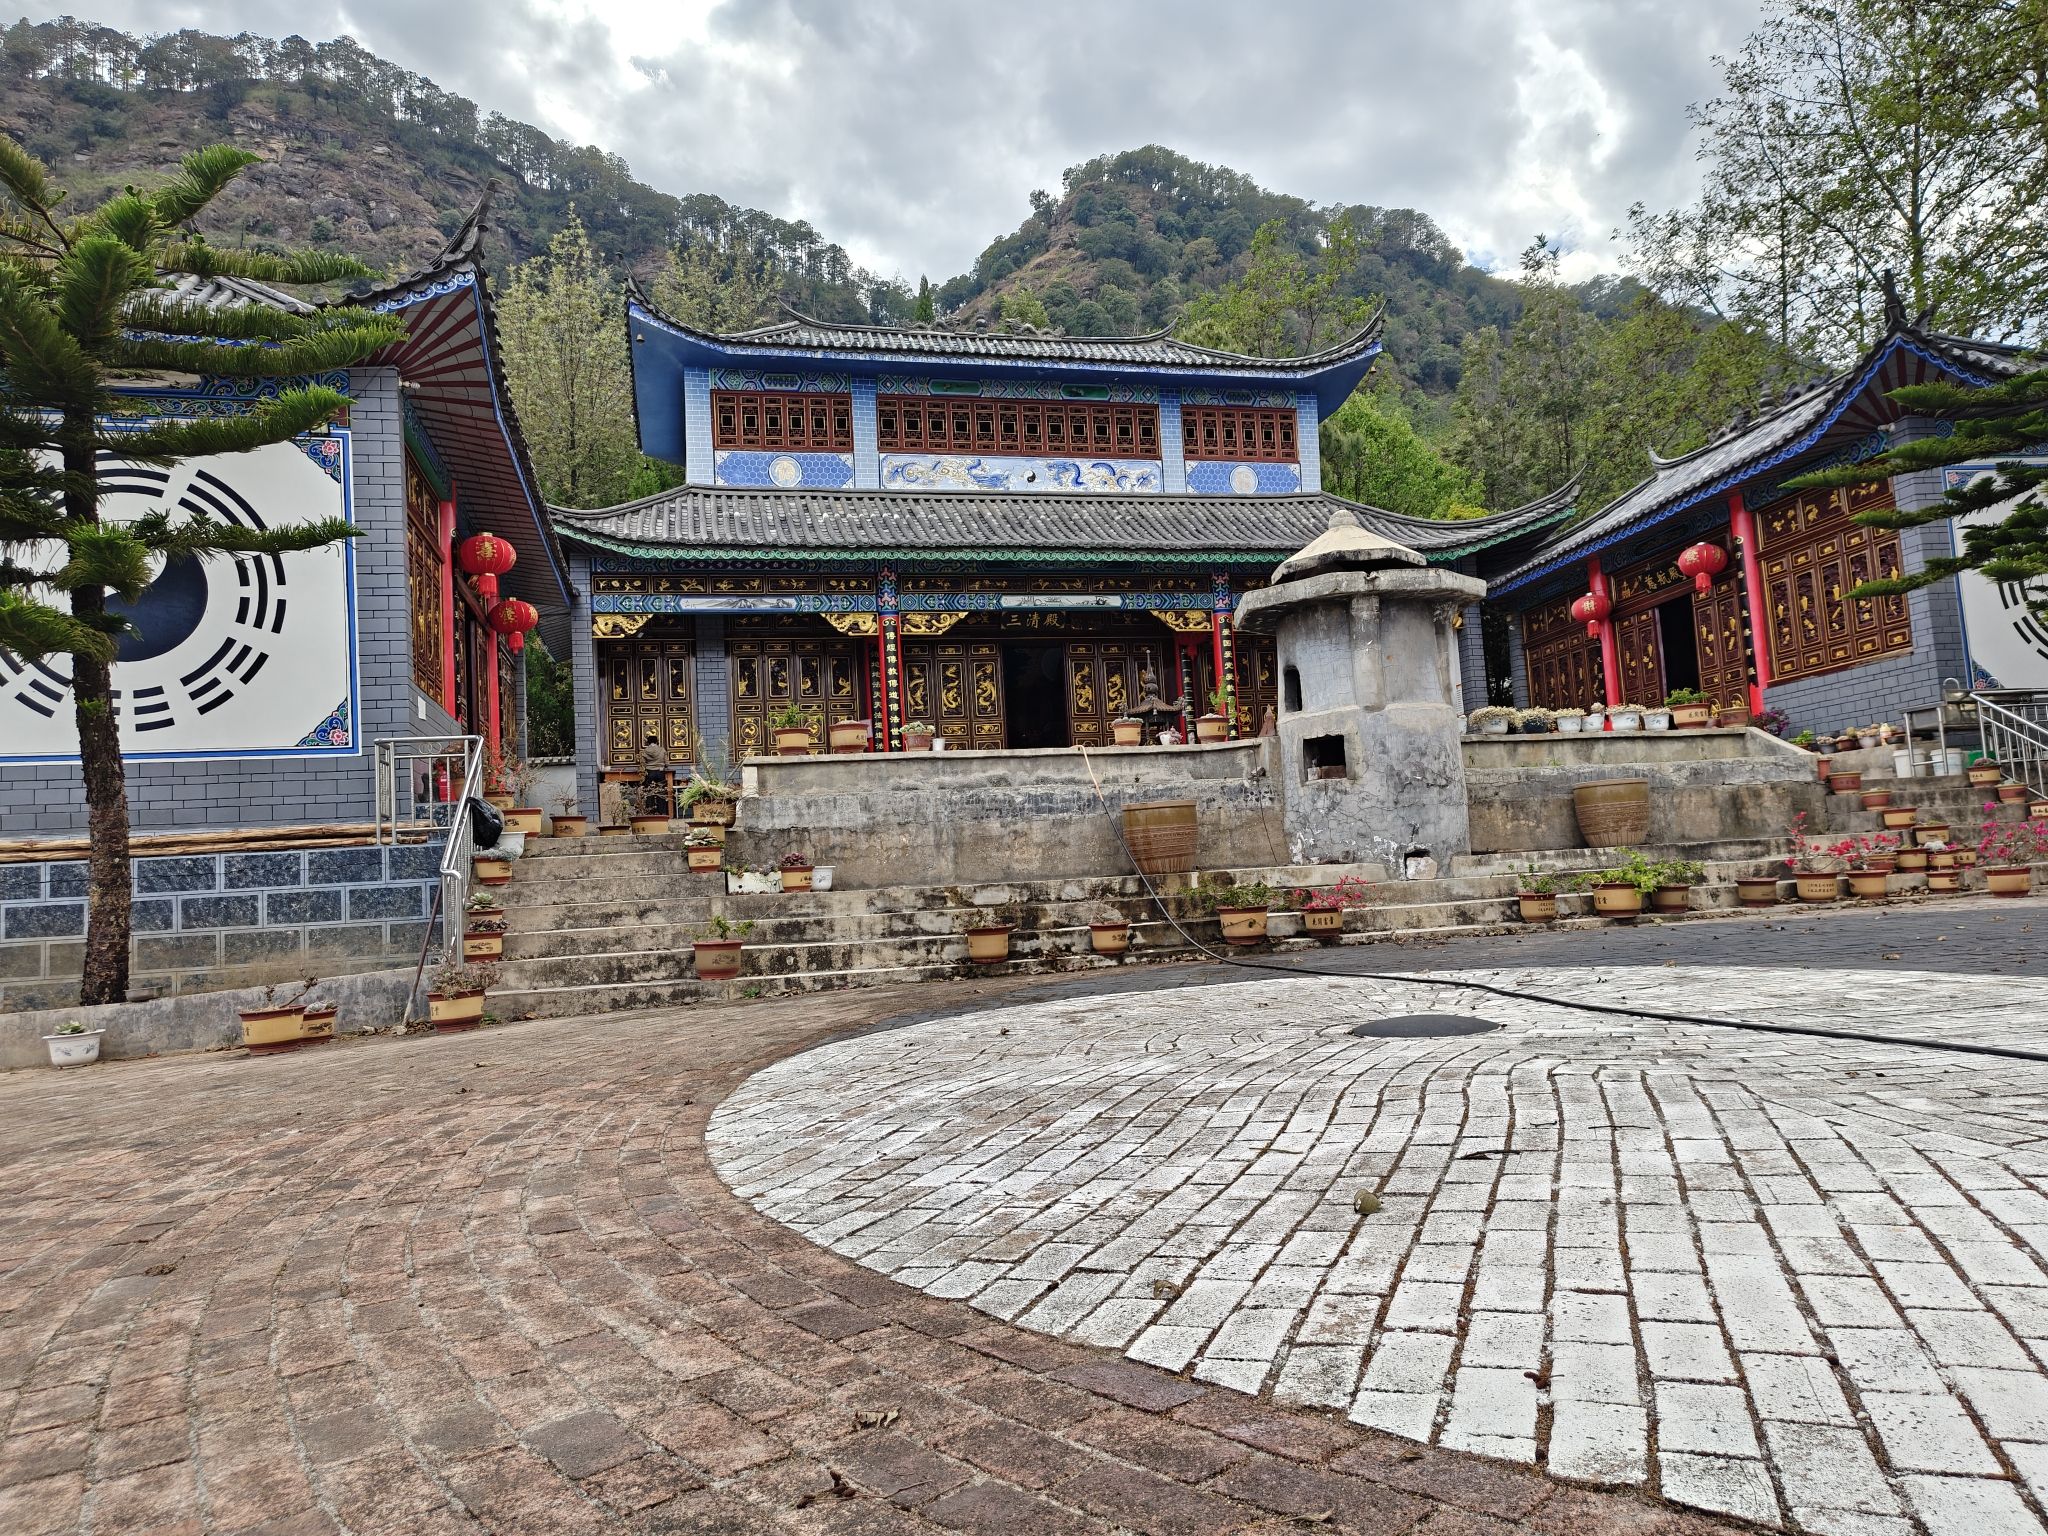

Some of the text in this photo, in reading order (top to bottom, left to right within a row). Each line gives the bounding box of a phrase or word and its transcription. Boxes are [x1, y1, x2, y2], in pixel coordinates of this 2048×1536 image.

[1644, 565, 1680, 590] 慈航殿
[1006, 611, 1061, 629] 三清殿
